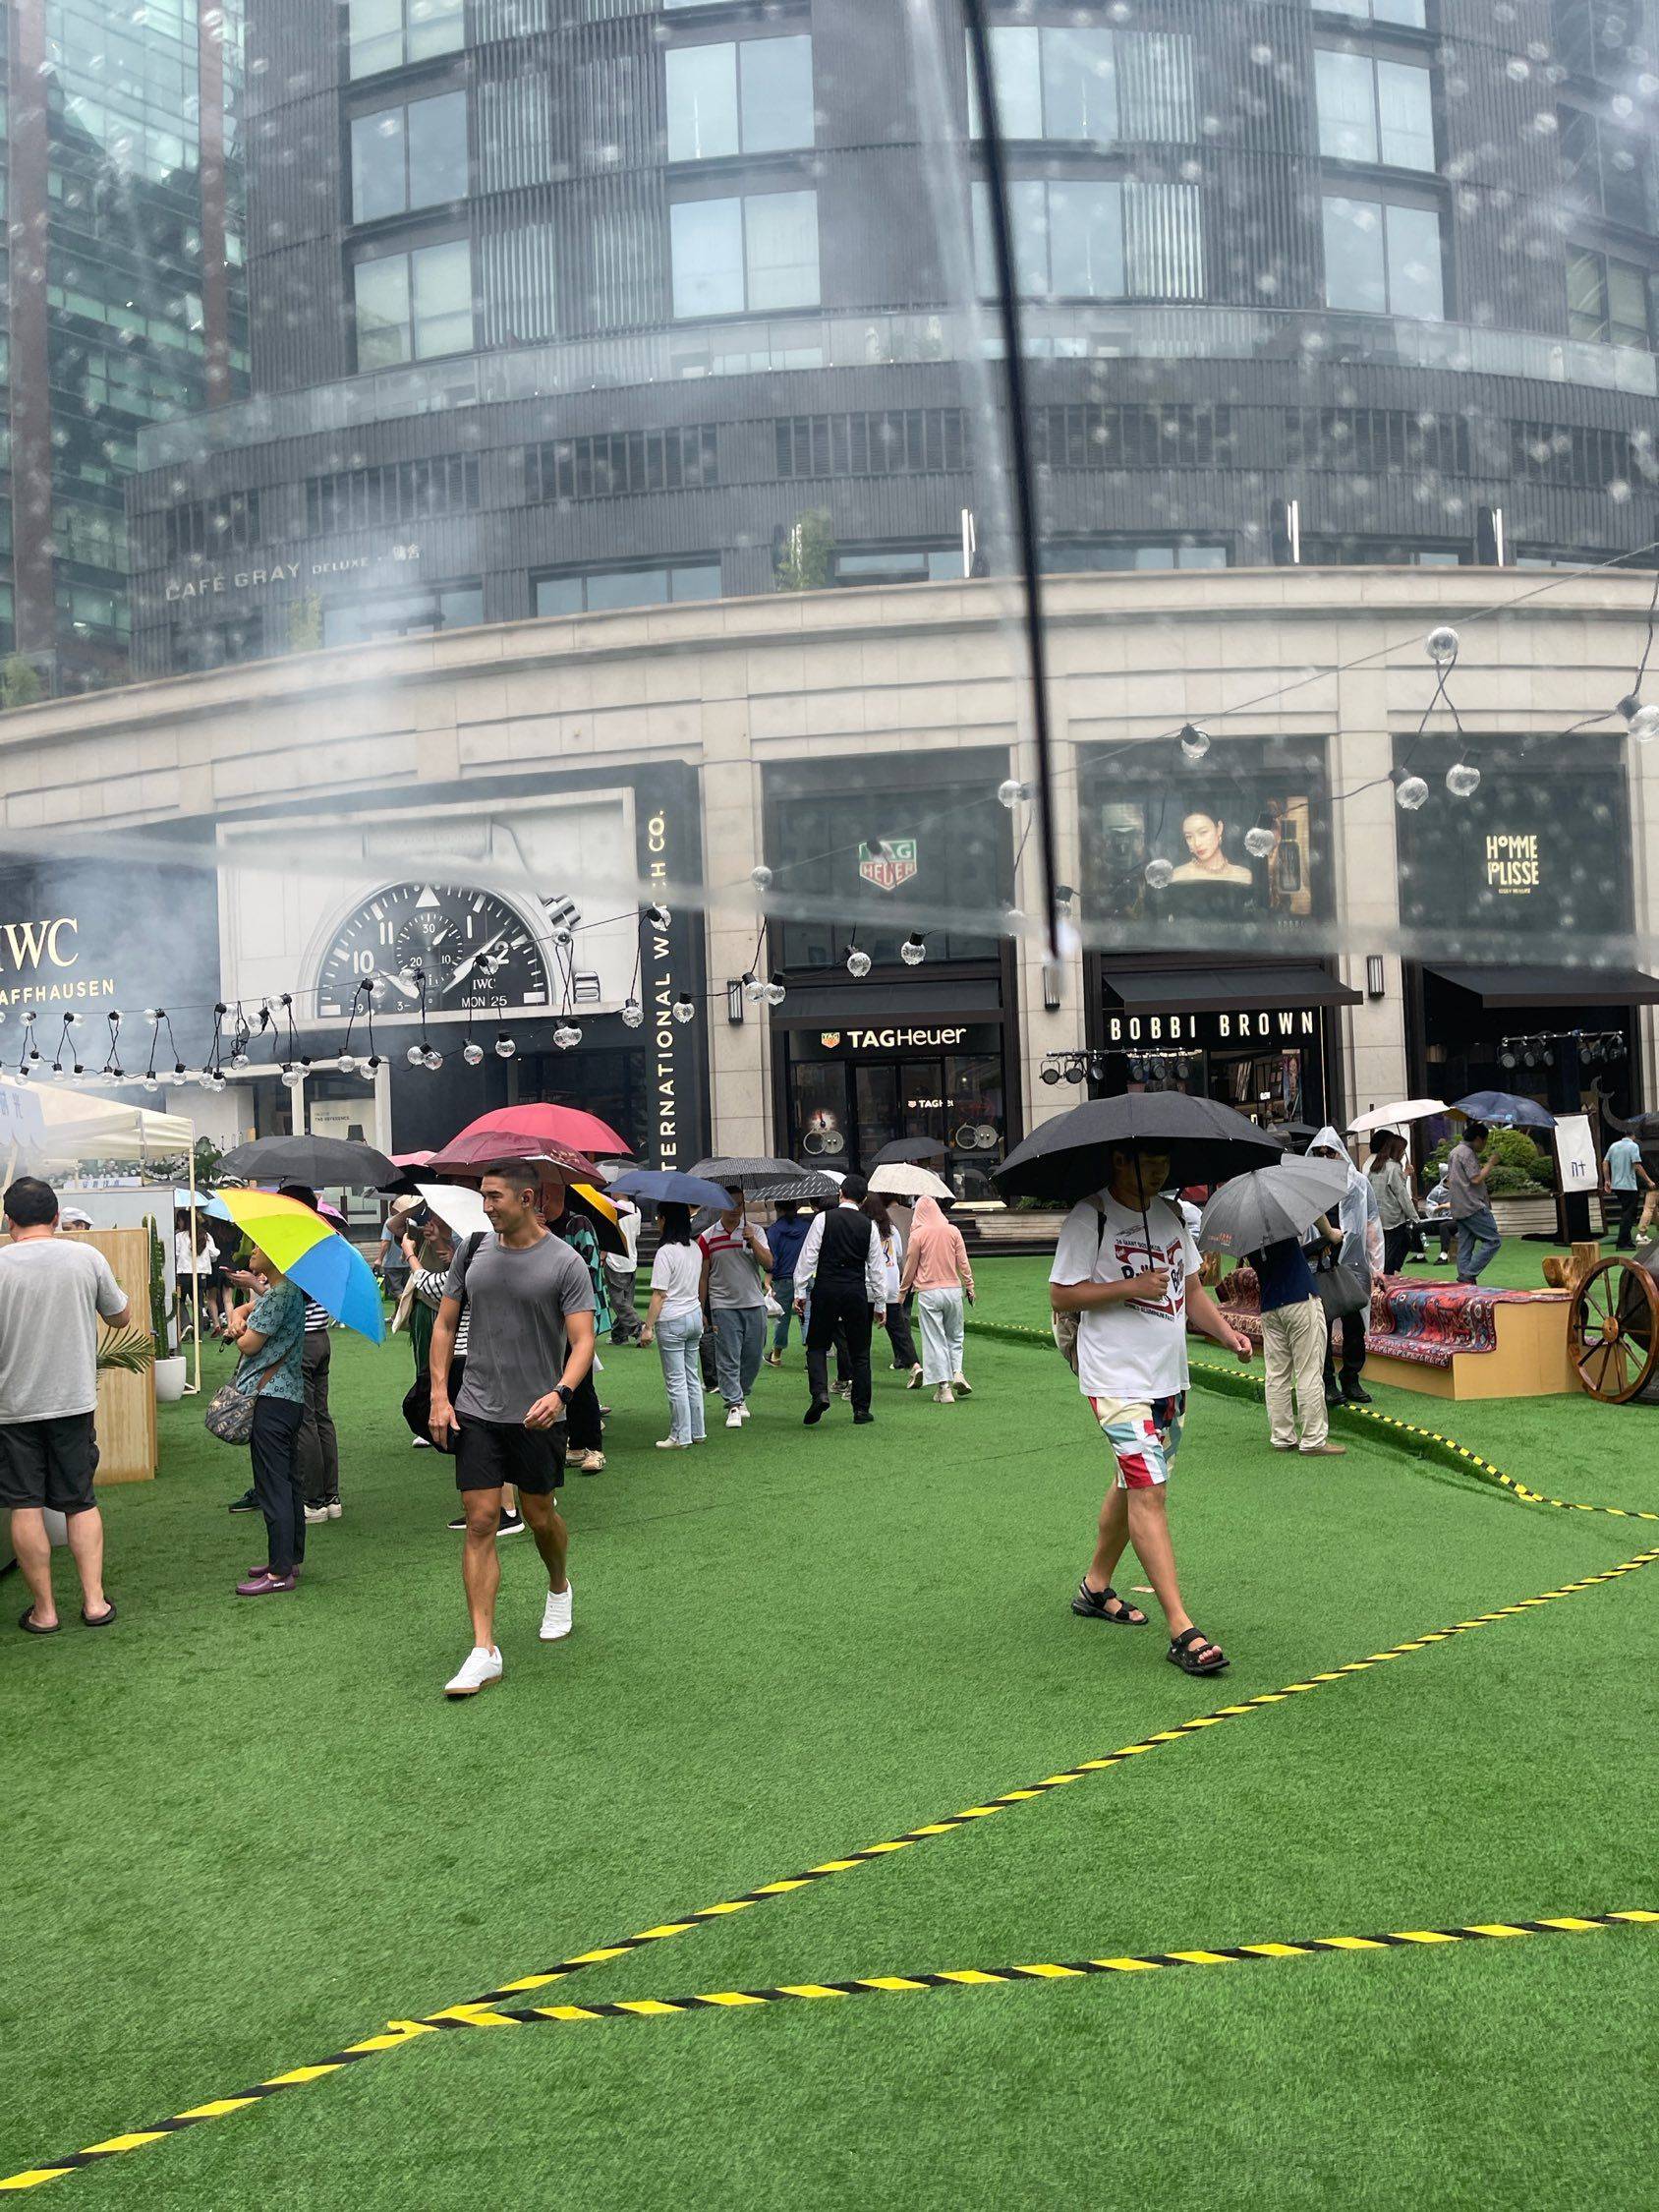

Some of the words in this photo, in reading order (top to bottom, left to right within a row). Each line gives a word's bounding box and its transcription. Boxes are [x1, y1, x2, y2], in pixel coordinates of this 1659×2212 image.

[234, 561, 300, 588] GRAY
[312, 556, 370, 575] DELUXE
[648, 810, 665, 852] CO.
[1486, 835, 1538, 859] HOMME
[423, 923, 436, 934] 30
[0, 917, 79, 971] WC
[353, 949, 375, 974] 10
[409, 957, 423, 967] 20
[473, 977, 496, 990] IWC
[461, 997, 486, 1009] MON
[490, 995, 508, 1008] 25
[1111, 1016, 1196, 1041] BOBBI
[1219, 1011, 1314, 1037] BROWN
[656, 972, 678, 1172] TERNATIONAL
